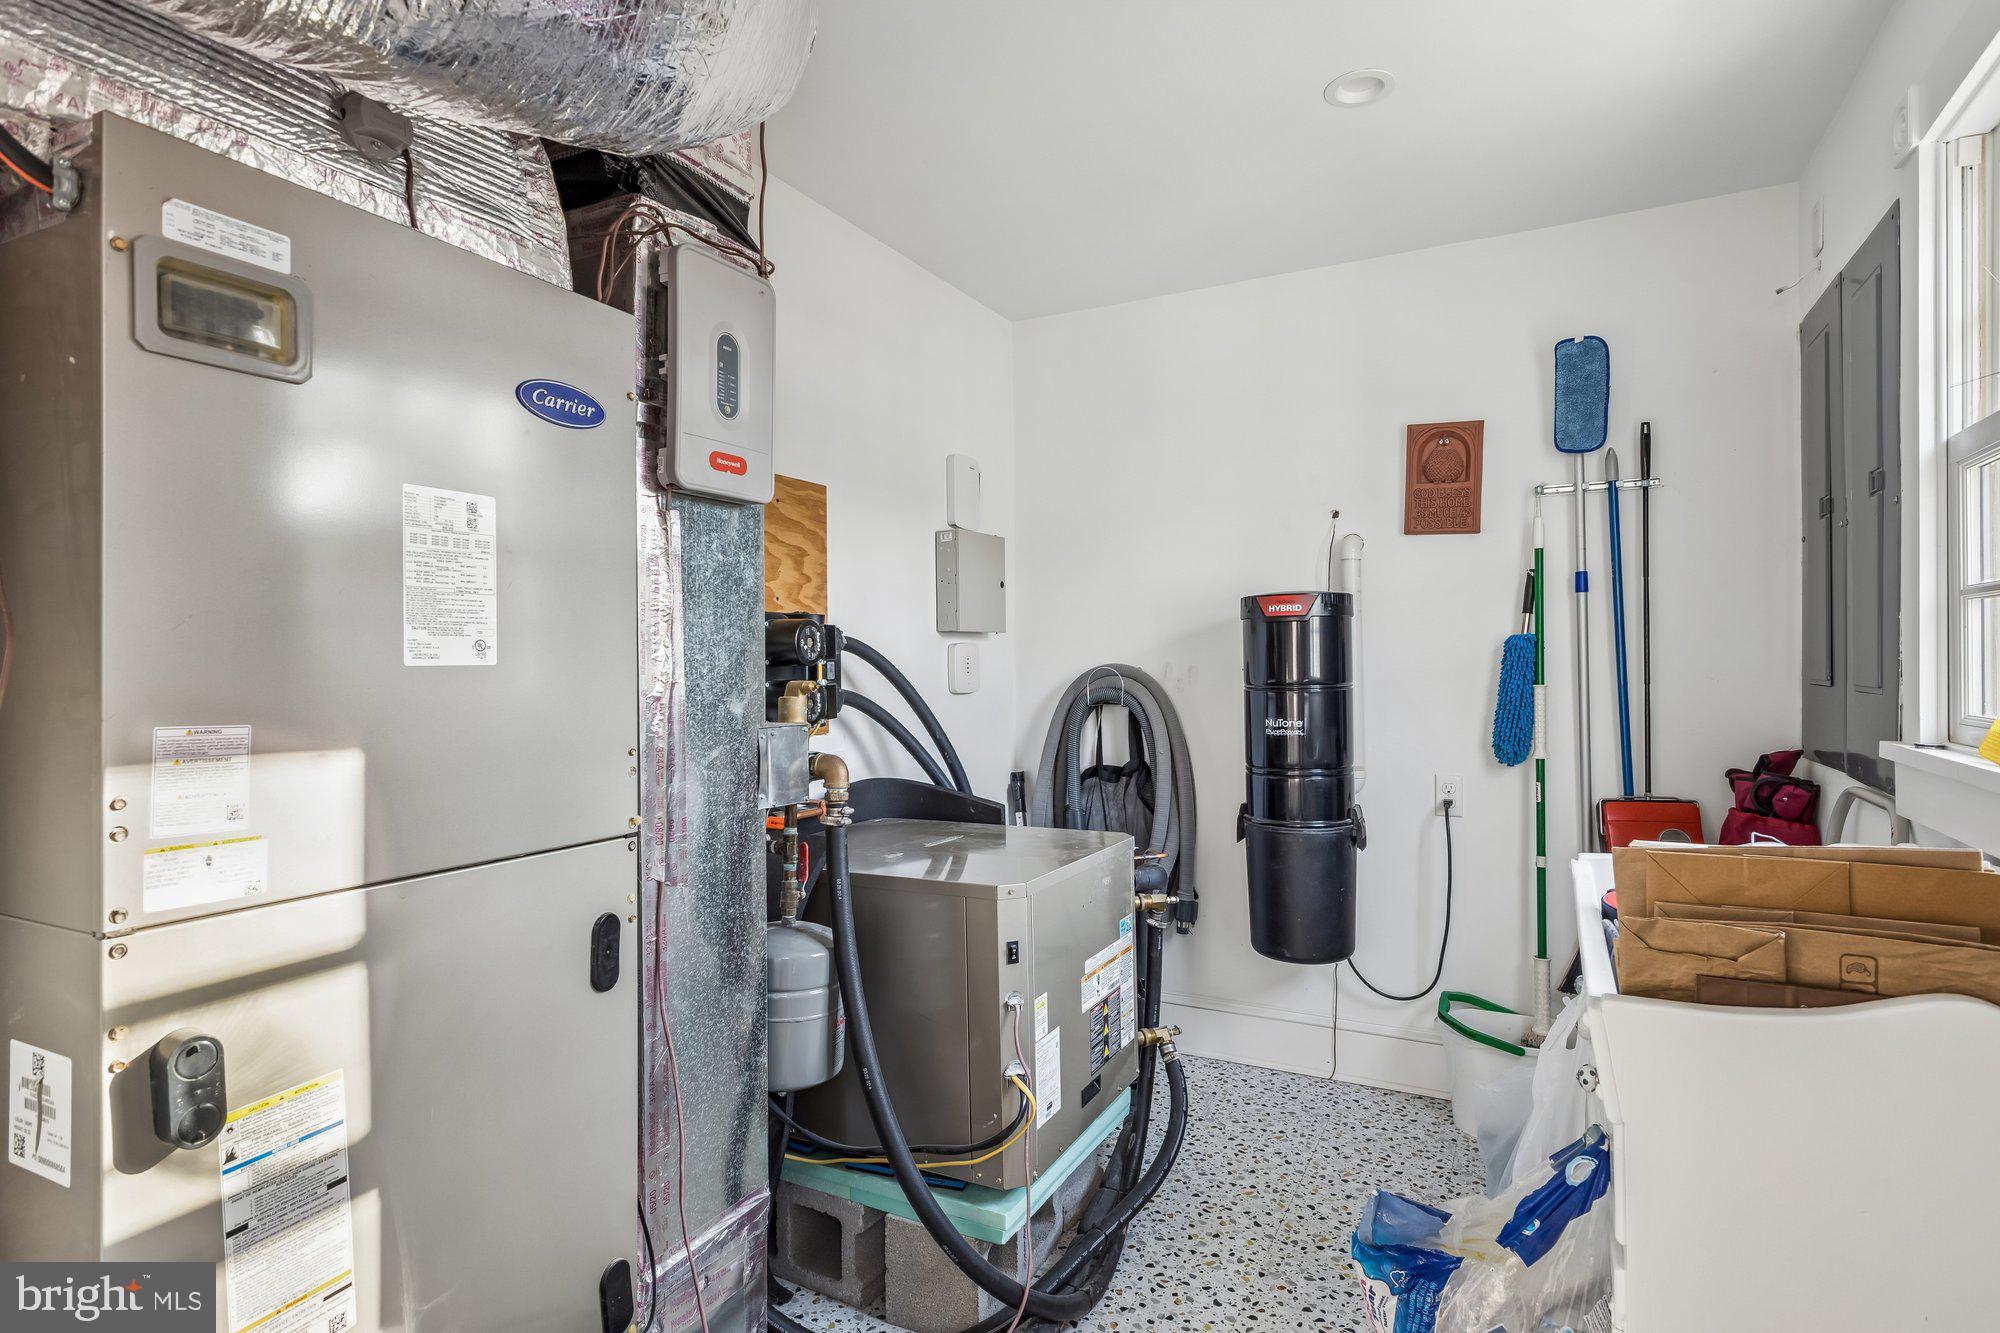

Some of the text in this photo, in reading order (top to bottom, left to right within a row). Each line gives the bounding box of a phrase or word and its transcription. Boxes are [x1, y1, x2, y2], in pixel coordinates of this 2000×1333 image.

[531, 388, 597, 418] Carrier
[715, 456, 741, 469] Honeywell
[1413, 487, 1471, 499] GOD BLESS
[1414, 497, 1471, 508] THIS HOME
[1268, 604, 1303, 613] HYBRID
[1265, 718, 1304, 728] NuTone
[193, 728, 223, 736] WARNING
[655, 821, 664, 846] 08/20
[247, 1101, 270, 1114] CAUTION
[663, 1180, 671, 1206] 05/20
[649, 1189, 657, 1215] 05/20
